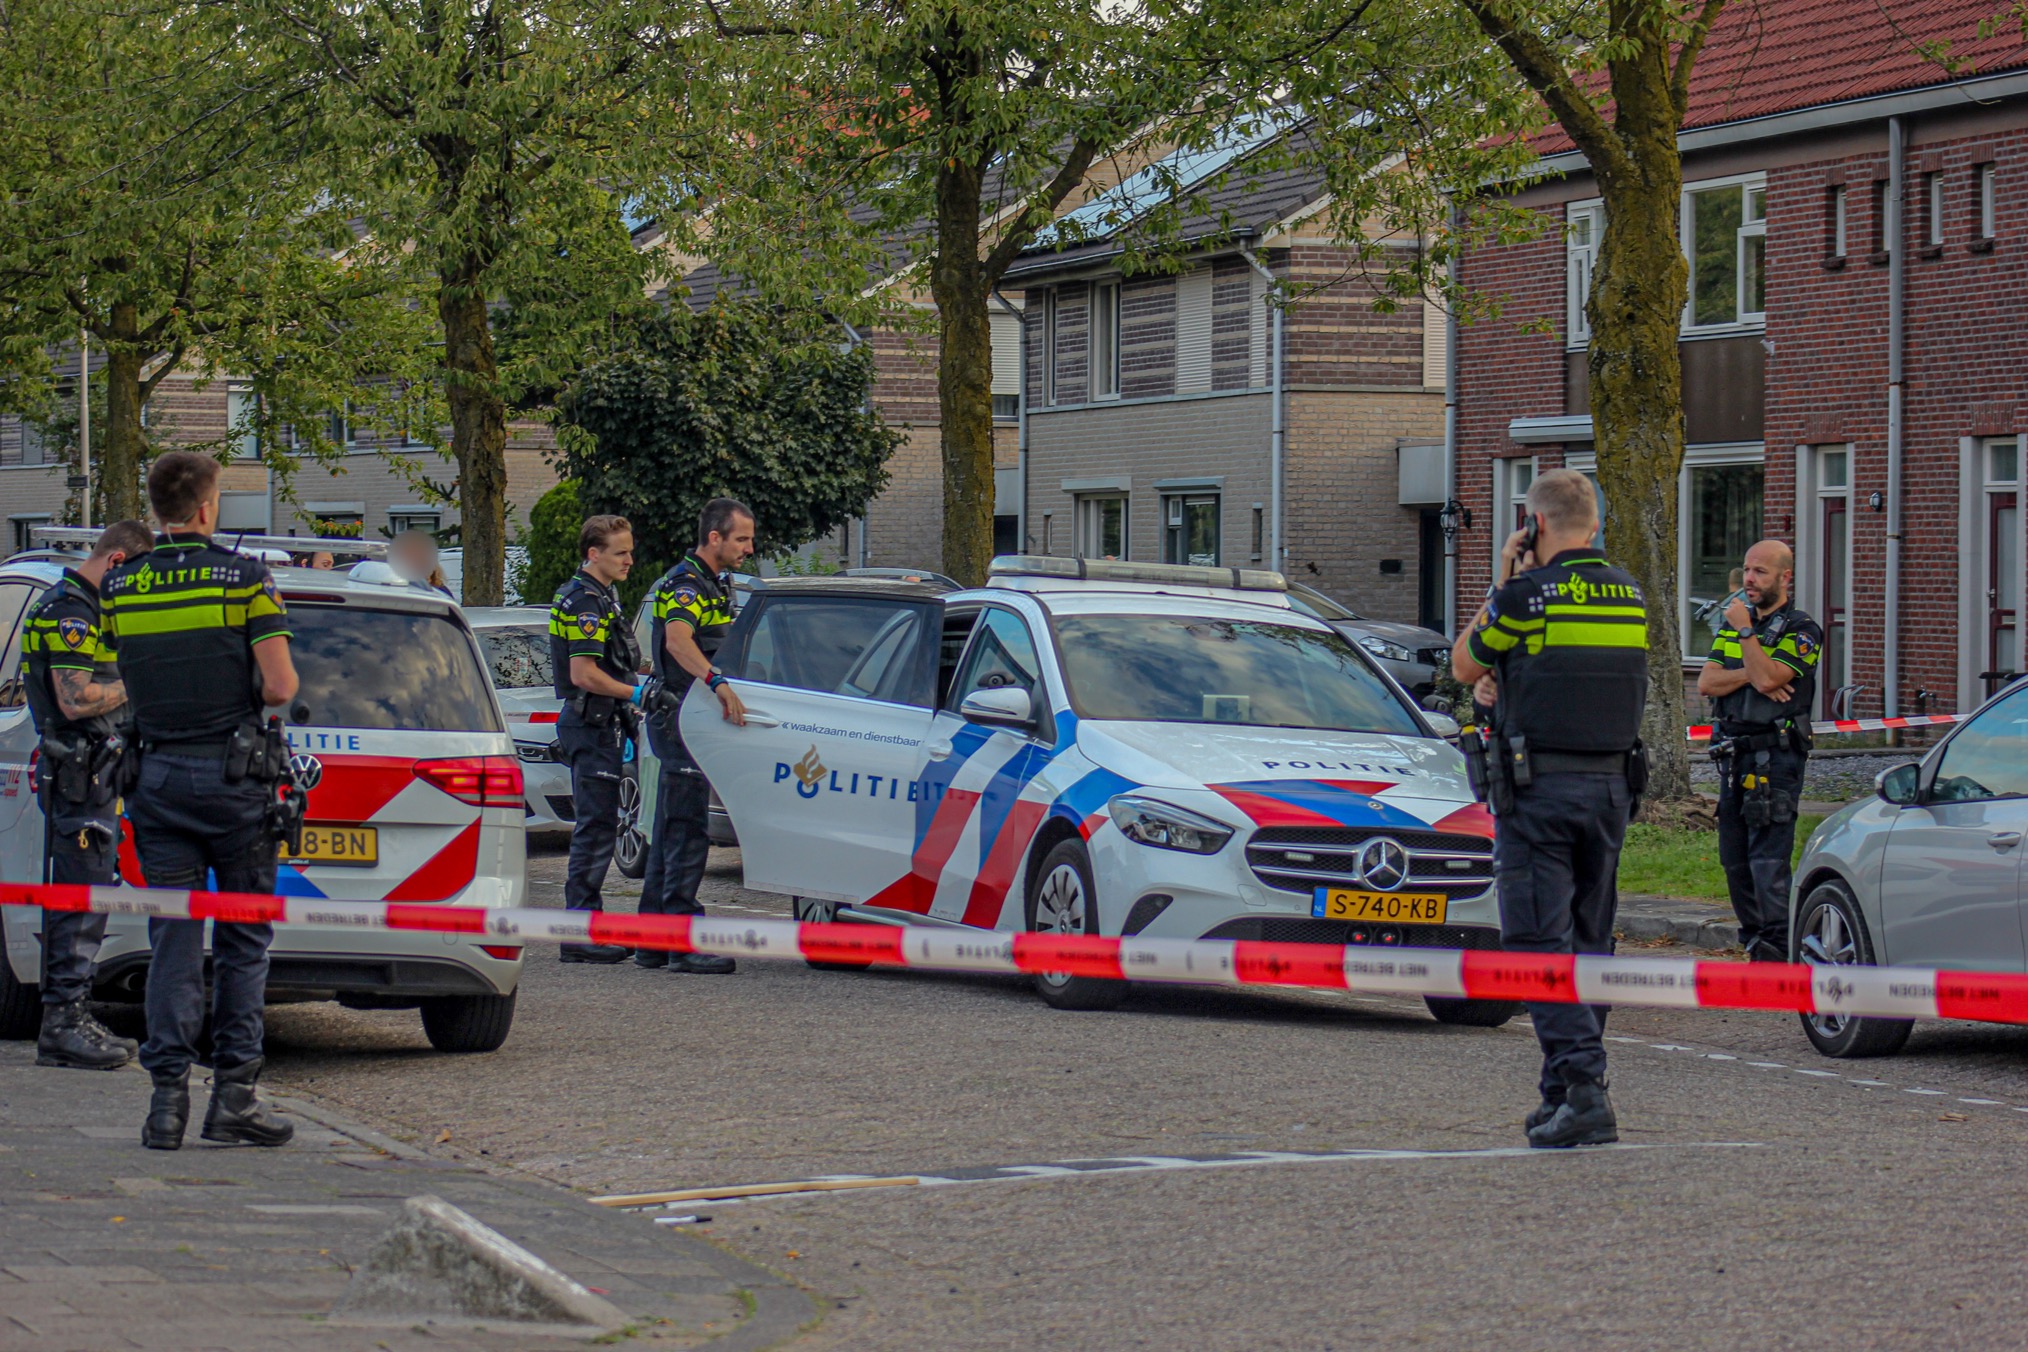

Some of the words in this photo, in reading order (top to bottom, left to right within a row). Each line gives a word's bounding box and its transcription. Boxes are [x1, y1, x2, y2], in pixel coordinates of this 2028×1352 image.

[125, 564, 212, 593] POLITIE
[1557, 575, 1634, 603] POLITIE
[288, 732, 360, 750] LITIE
[791, 722, 847, 737] waakzaam
[849, 730, 862, 739] en
[864, 731, 920, 747] dienstbaar
[1262, 760, 1416, 776] POLITIE
[279, 831, 367, 856] 8-BN
[1333, 894, 1438, 918] S-740-KB
[306, 912, 368, 926] BETREDEN
[1398, 964, 1428, 977] NIET
[1601, 972, 1675, 987] BETREDEN
